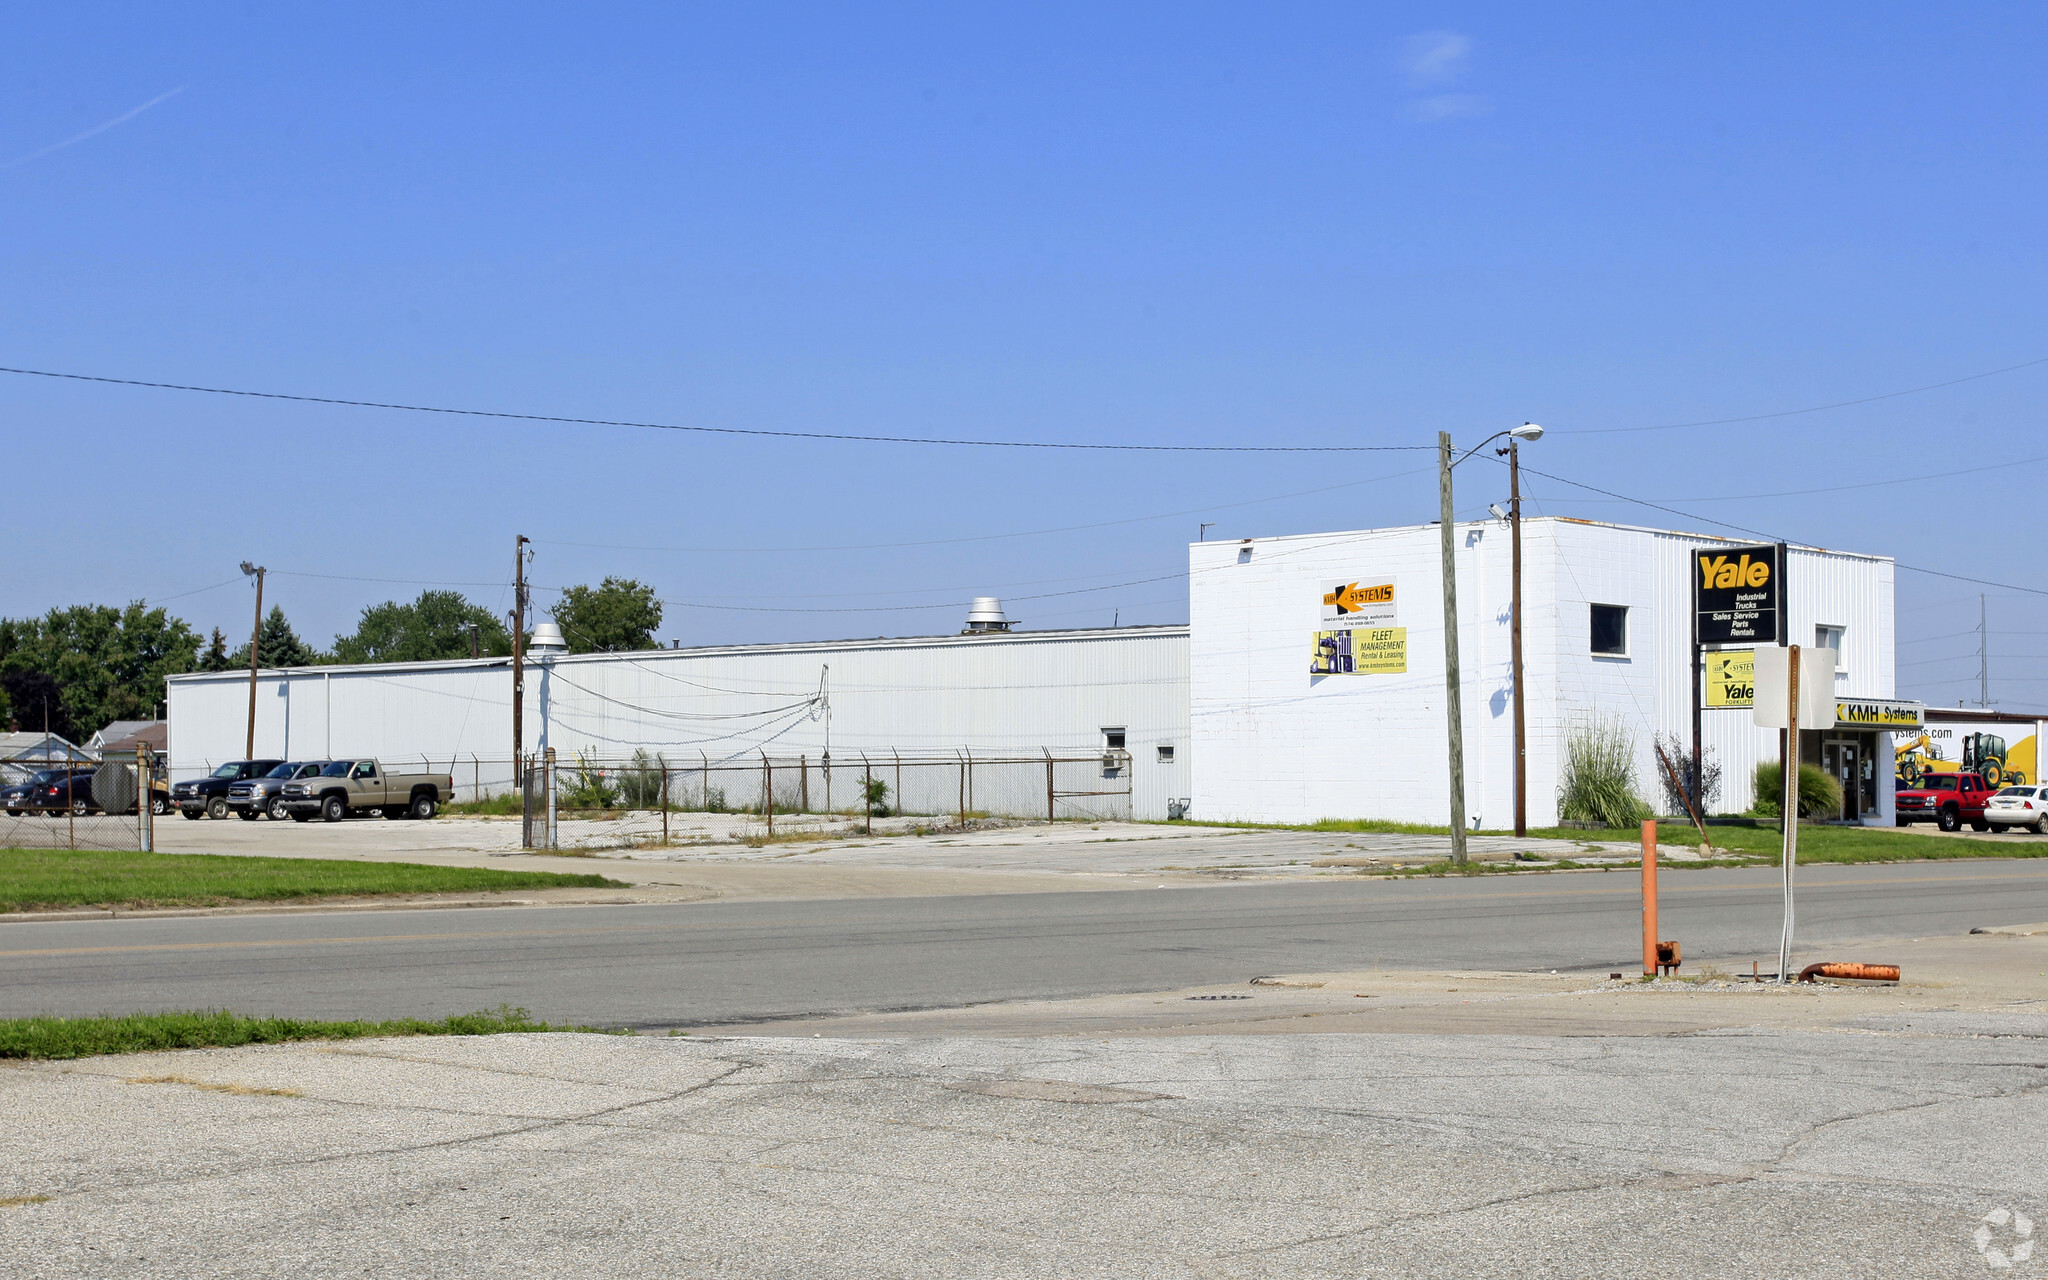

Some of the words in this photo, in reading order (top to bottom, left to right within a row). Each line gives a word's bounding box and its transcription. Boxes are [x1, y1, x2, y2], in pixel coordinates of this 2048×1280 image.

[1699, 554, 1770, 590] Yale
[1350, 586, 1393, 602] SYSTEMS
[1736, 592, 1767, 601] Industrial
[1735, 602, 1757, 610] Trucks
[1712, 613, 1731, 621] Sales
[1733, 612, 1759, 620] Service
[1732, 620, 1749, 628] Parts
[1371, 630, 1393, 641] FLEET
[1730, 628, 1755, 636] Rentals
[1360, 641, 1404, 651] MANAGEMENT
[1384, 651, 1404, 659] Leasing
[1724, 684, 1754, 699] Yale
[1848, 704, 1879, 722] KMH
[1884, 706, 1918, 722] Systems
